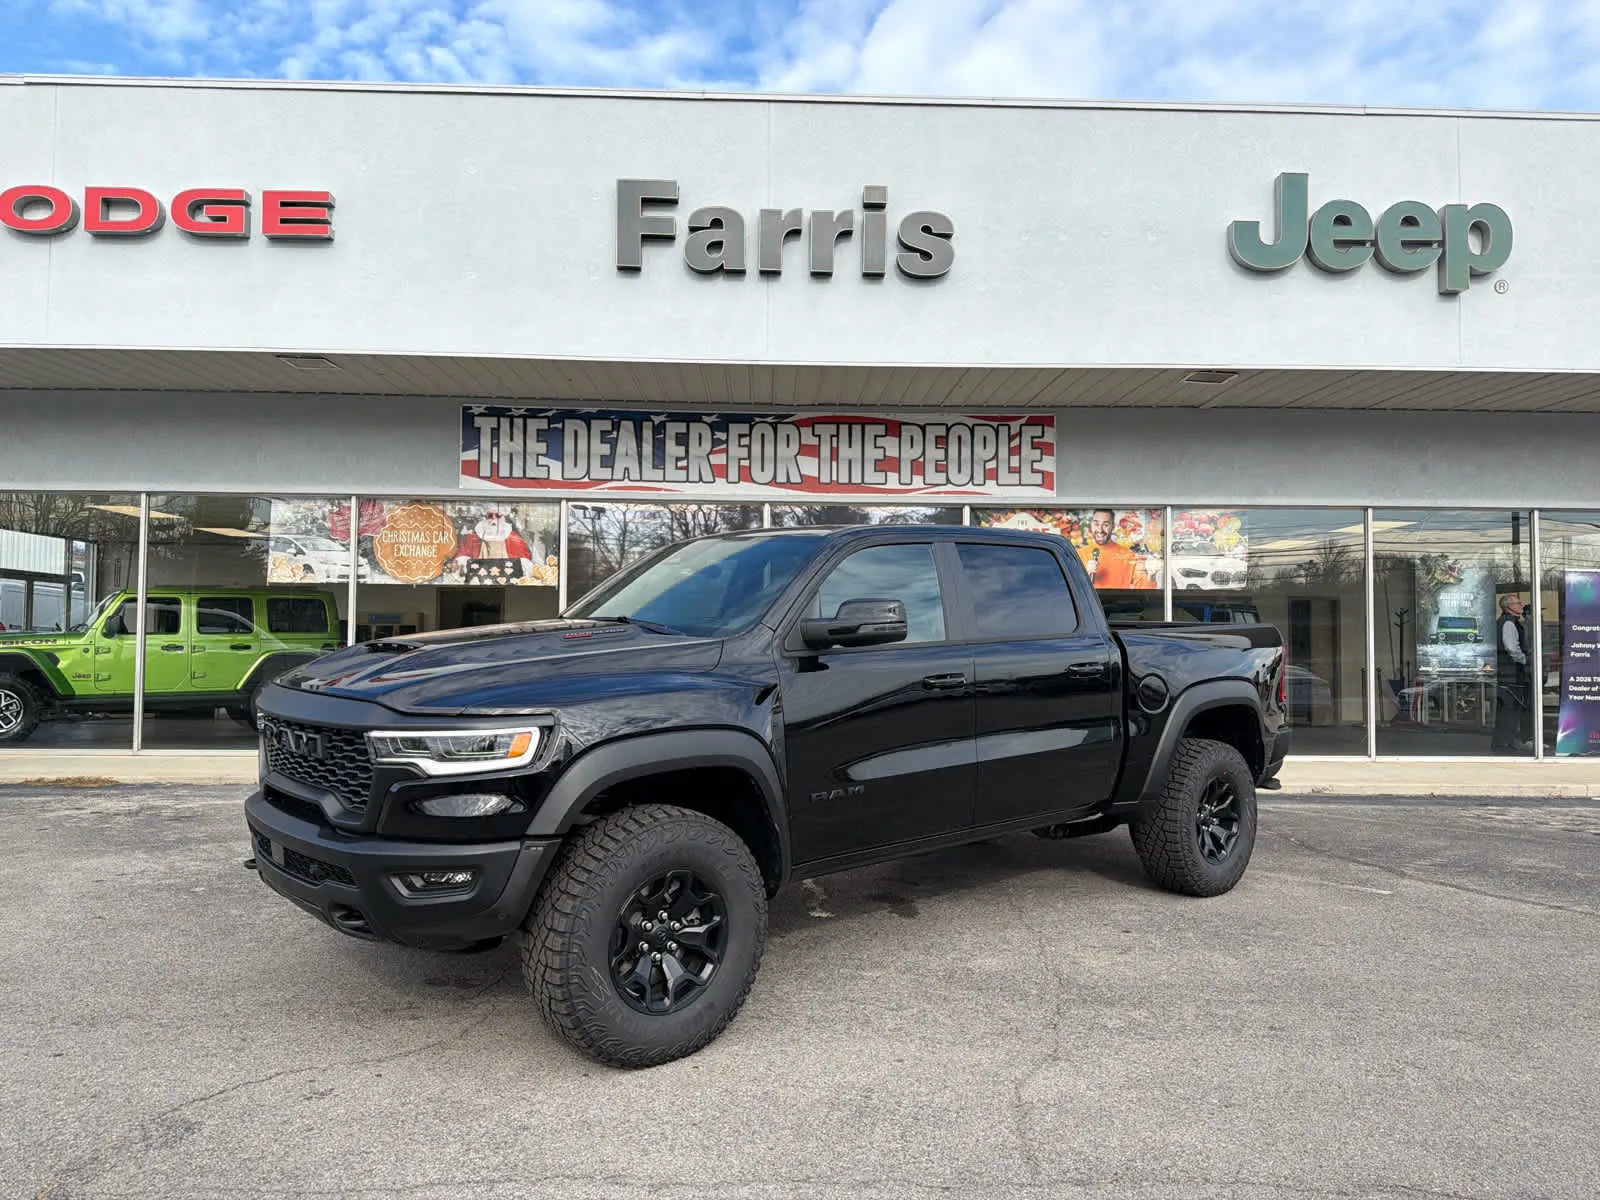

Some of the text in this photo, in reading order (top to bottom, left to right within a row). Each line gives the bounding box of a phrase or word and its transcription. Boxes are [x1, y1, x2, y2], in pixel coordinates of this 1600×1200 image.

[0, 184, 336, 241] ODGE
[615, 178, 955, 280] Farris
[1228, 172, 1513, 295] Jeep
[474, 415, 1045, 486] THE DEALER FOR THE PEOPLE
[382, 530, 449, 544] CHRISTMAS CAR
[394, 543, 438, 557] EXCHANGE
[809, 784, 865, 802] RAM
